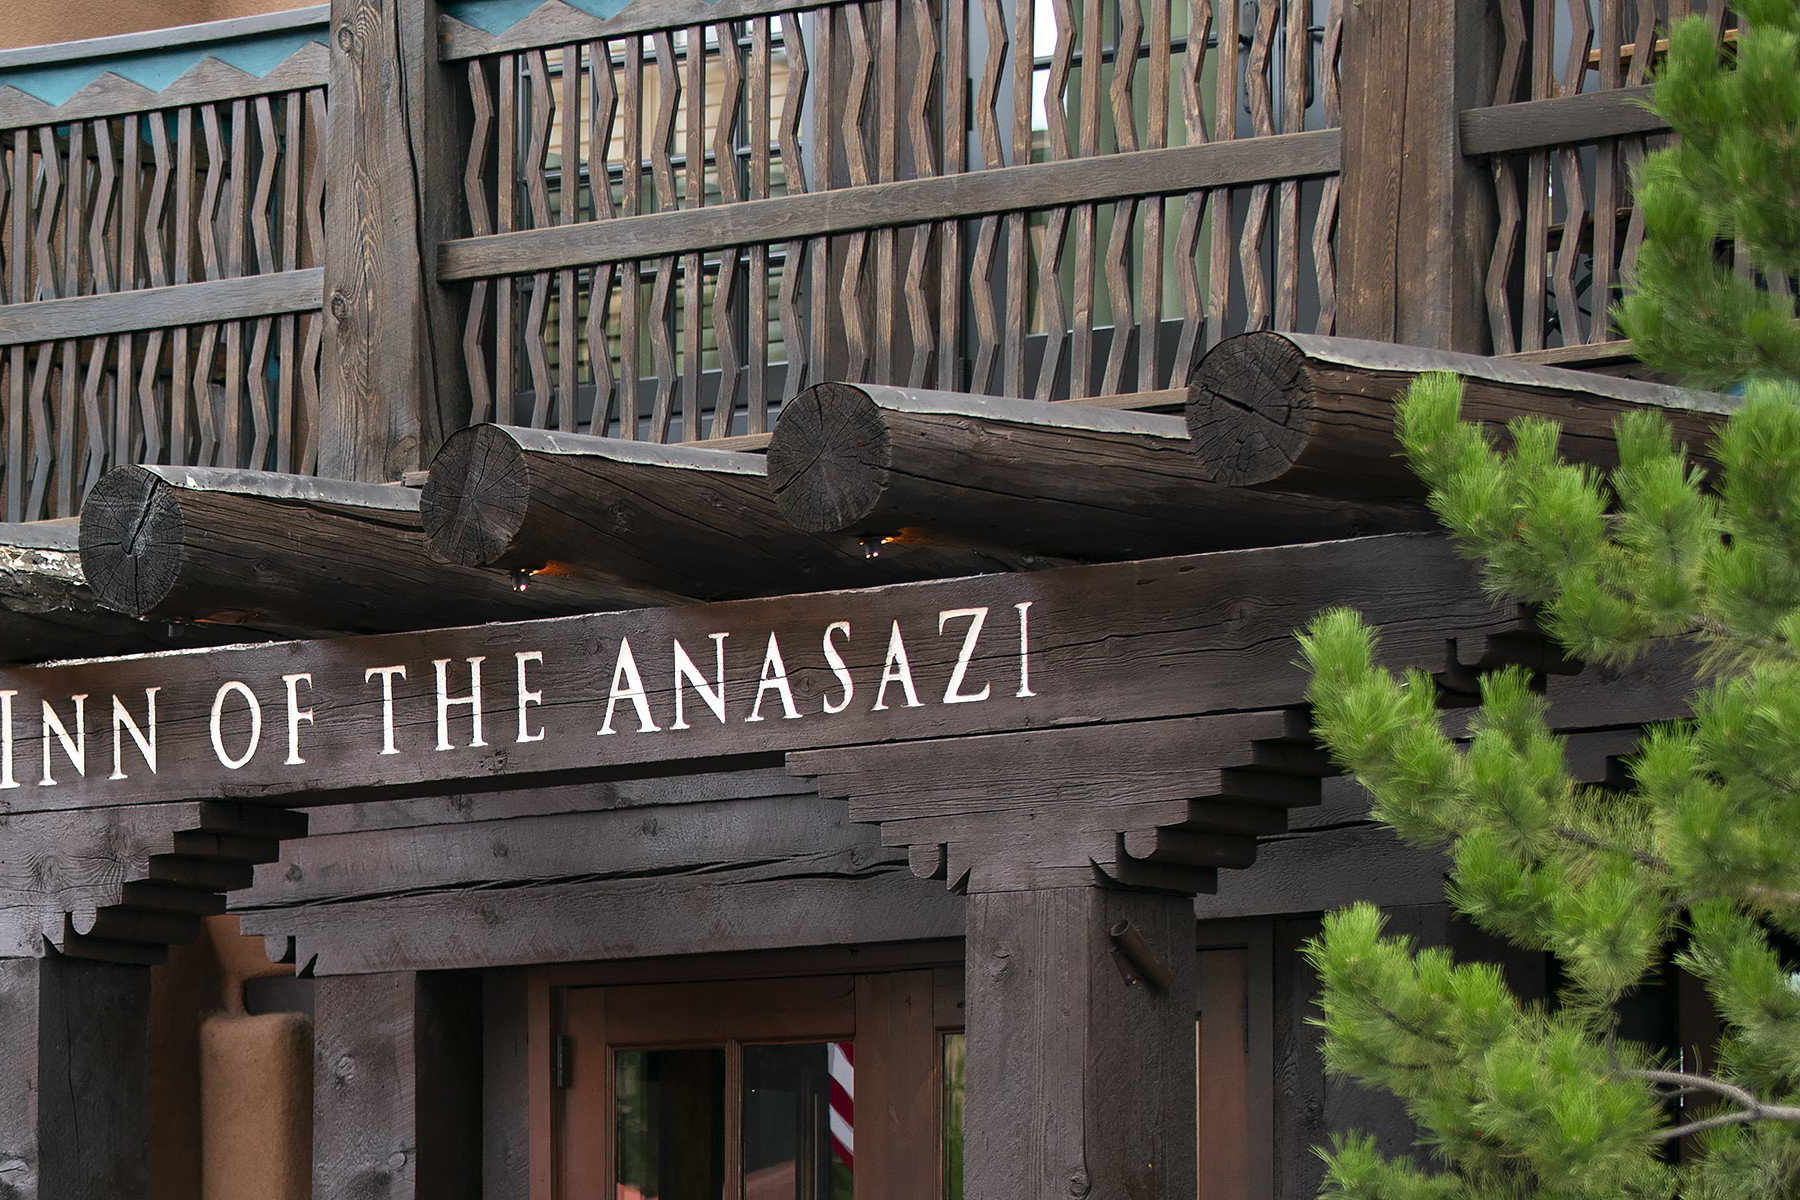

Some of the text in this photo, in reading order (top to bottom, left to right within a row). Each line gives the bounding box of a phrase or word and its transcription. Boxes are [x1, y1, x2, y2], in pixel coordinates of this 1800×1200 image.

[209, 672, 315, 770] OF
[364, 650, 546, 756] THE
[596, 600, 1034, 736] ANASAZI
